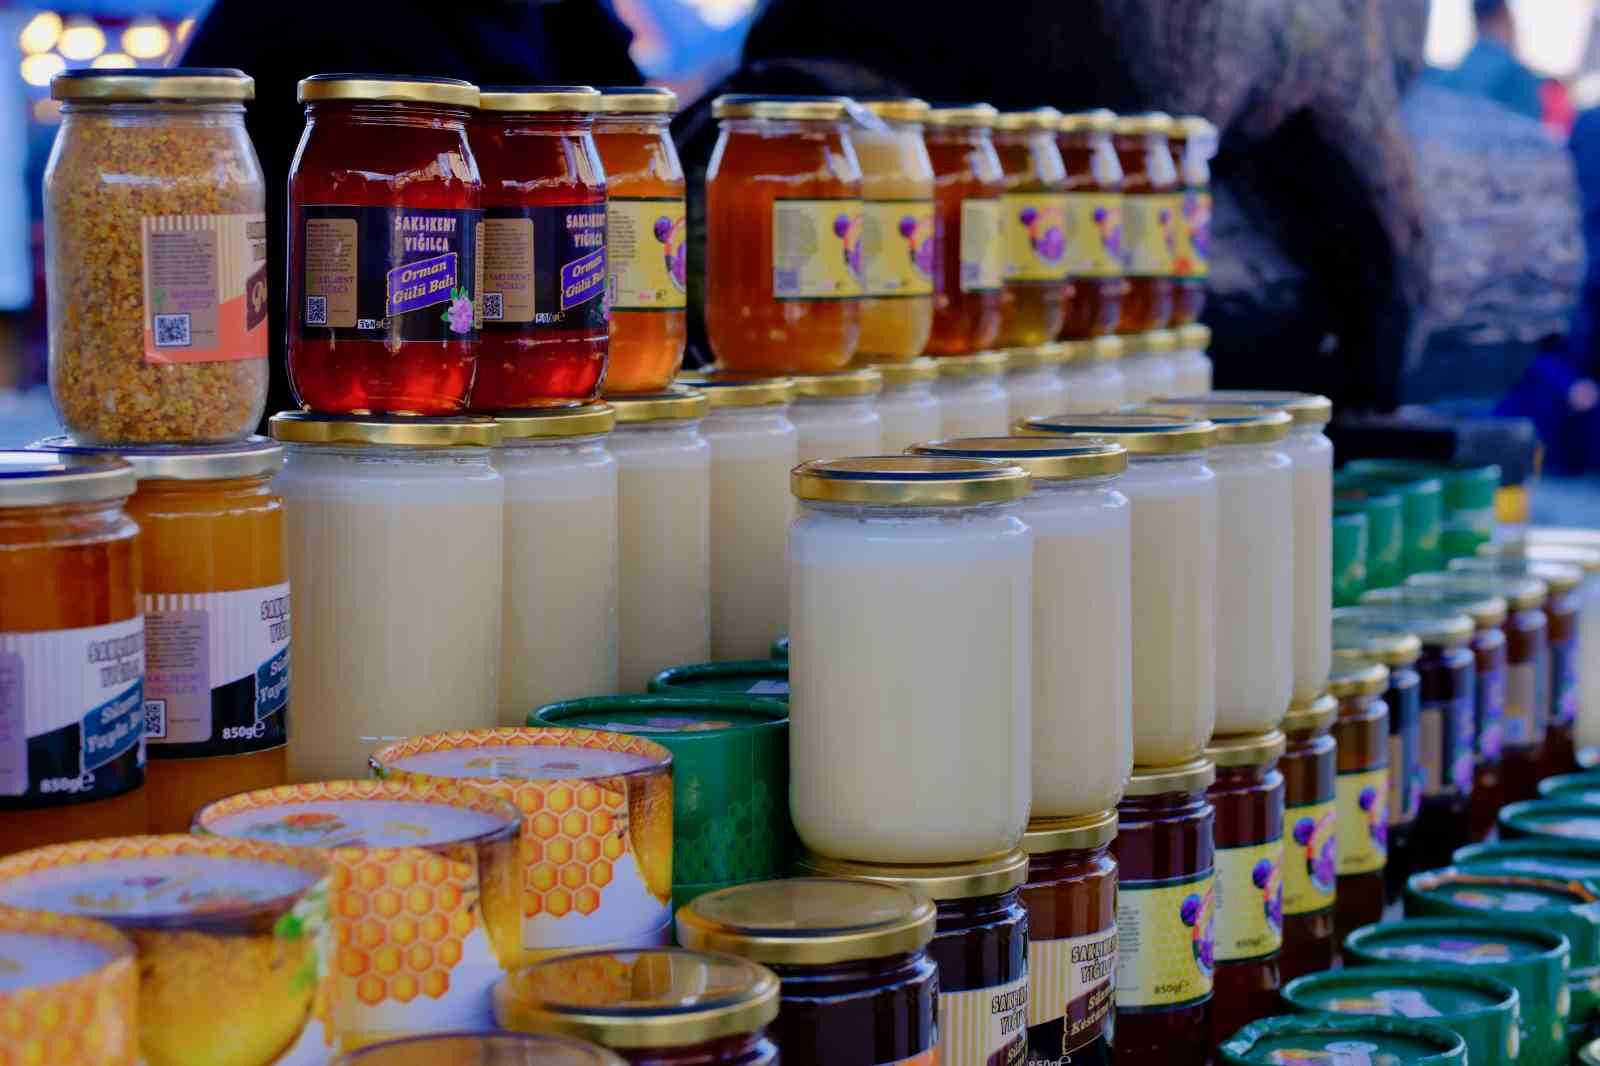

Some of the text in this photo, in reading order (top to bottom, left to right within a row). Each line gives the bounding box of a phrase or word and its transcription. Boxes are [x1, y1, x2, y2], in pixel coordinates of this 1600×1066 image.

[395, 216, 456, 231] SAKLIKENT
[404, 233, 449, 252] YIĞILCA
[401, 261, 447, 283] Orman
[393, 283, 426, 305] Gülü
